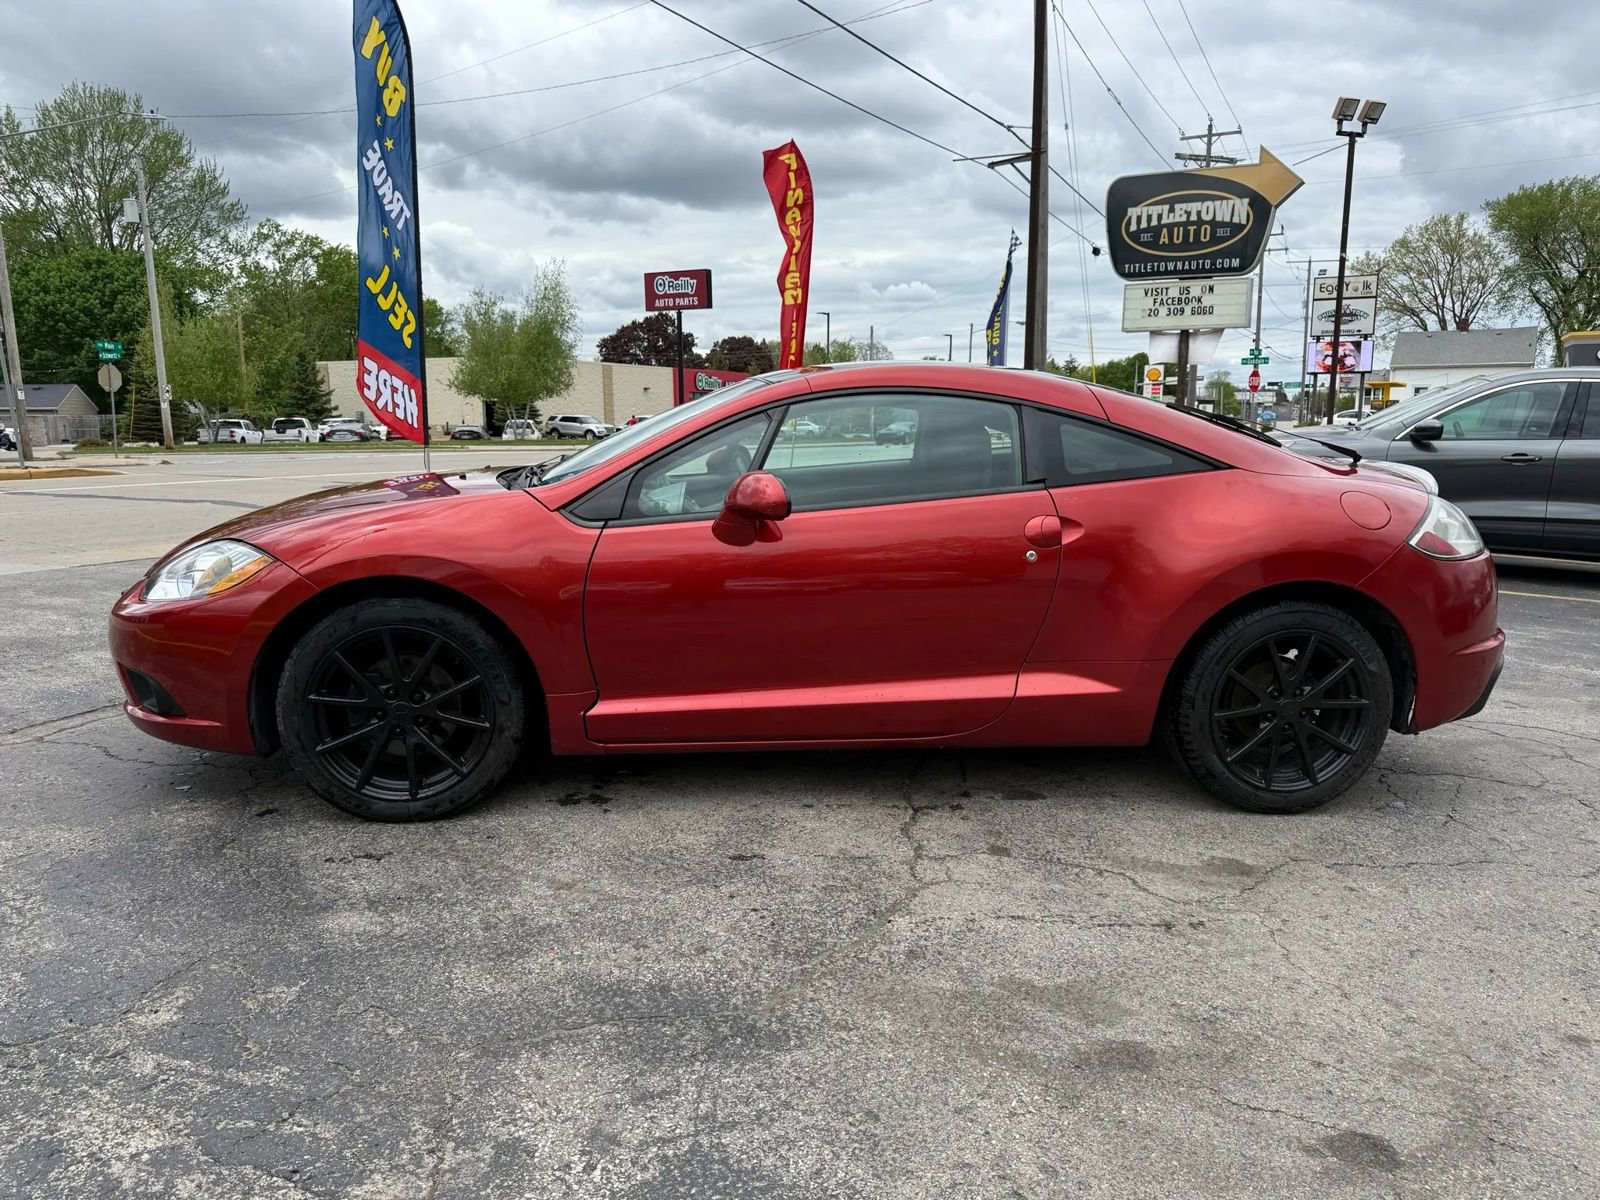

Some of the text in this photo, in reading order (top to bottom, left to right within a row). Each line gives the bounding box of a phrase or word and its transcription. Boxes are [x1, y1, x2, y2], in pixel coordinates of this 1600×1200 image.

[1126, 197, 1250, 233] TITLETOWN
[1159, 224, 1211, 245] AUTO
[1124, 257, 1240, 274] TITLETOWNAUTO.COM
[654, 276, 697, 295] O'Reilly
[1144, 284, 1215, 297] VISIT US ON
[655, 297, 699, 308] AUTO PARTS
[1153, 296, 1203, 307] FACEBOOK
[1166, 306, 1185, 317] 309
[1190, 305, 1215, 316] 6060
[1249, 377, 1260, 387] STOP
